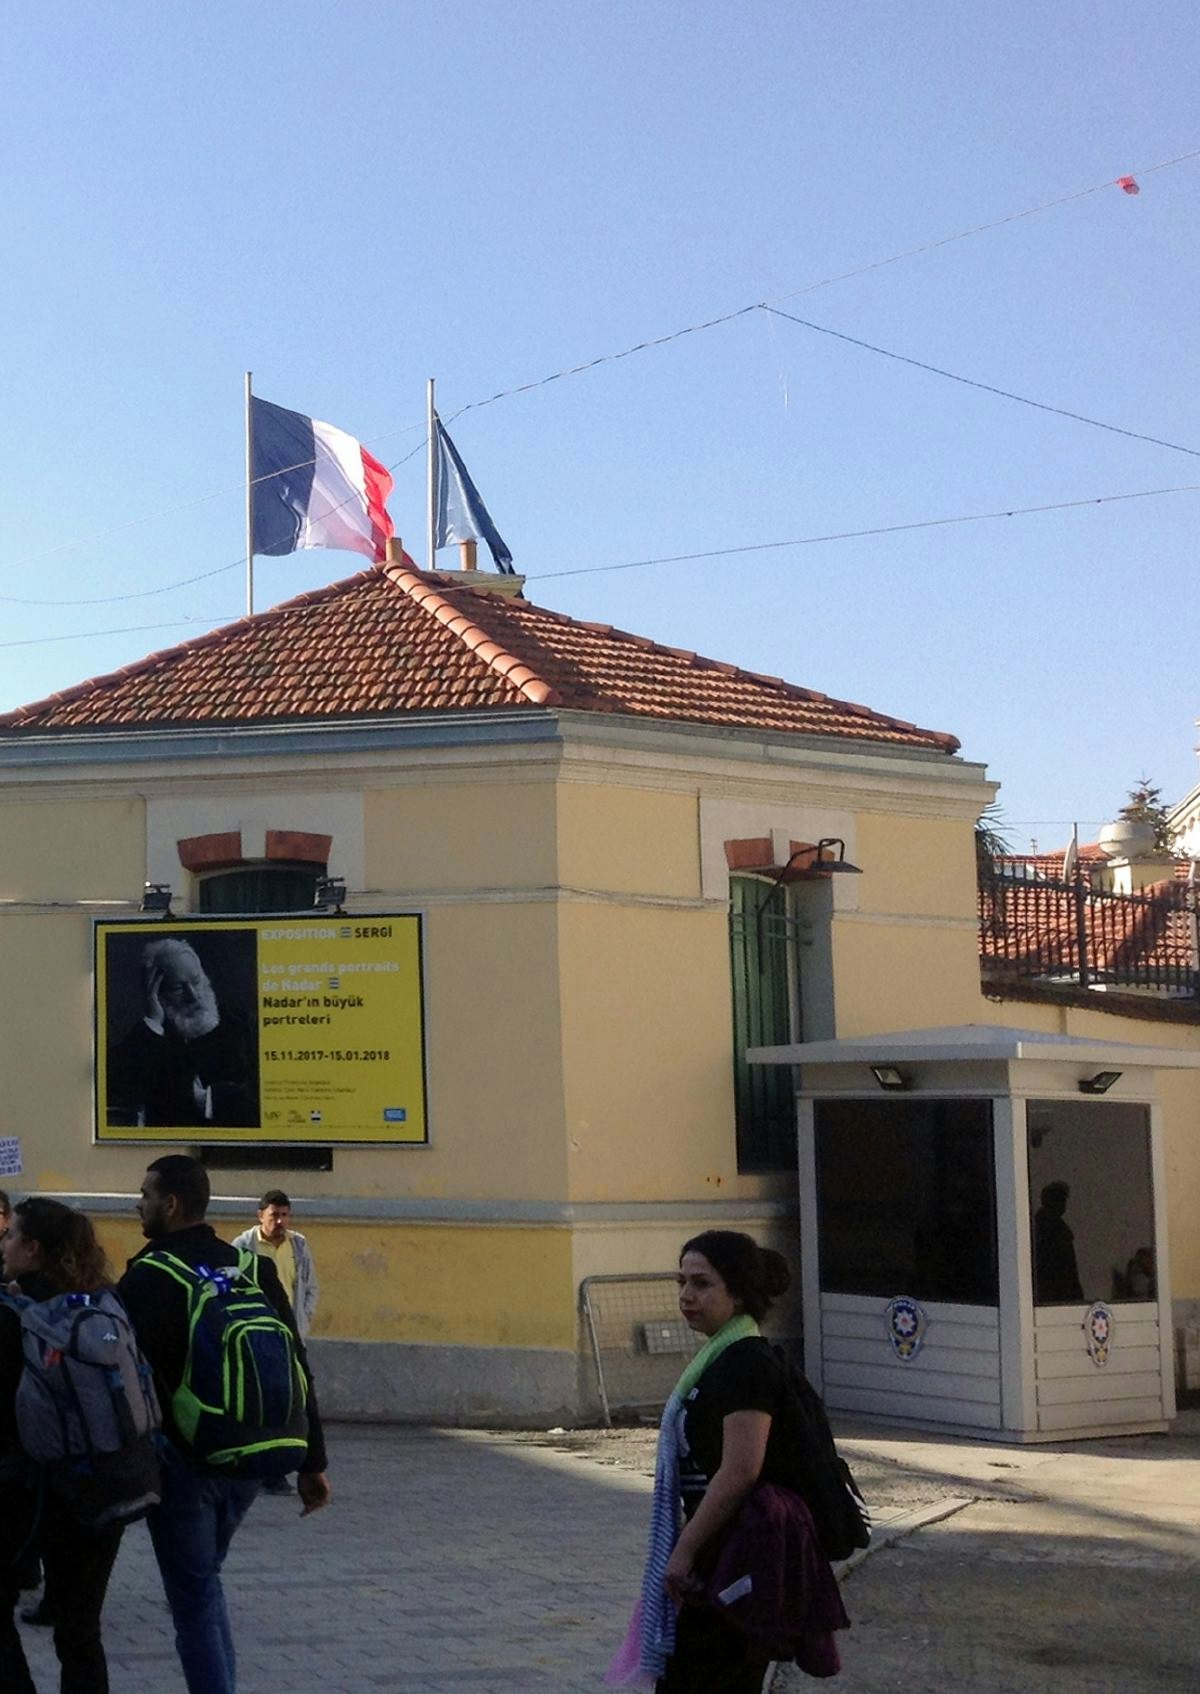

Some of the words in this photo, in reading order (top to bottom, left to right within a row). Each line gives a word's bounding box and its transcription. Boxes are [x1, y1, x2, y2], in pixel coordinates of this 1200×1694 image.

[262, 928, 337, 940] EXPOSITION
[355, 926, 392, 938] SERGİ
[262, 964, 285, 974] Les
[288, 962, 336, 976] grands
[338, 961, 400, 975] portraits
[262, 980, 278, 991] de
[282, 979, 322, 991] Nadar
[263, 996, 319, 1009] Nadar'ın
[324, 995, 364, 1010] büyük
[263, 1014, 331, 1027] portreleri
